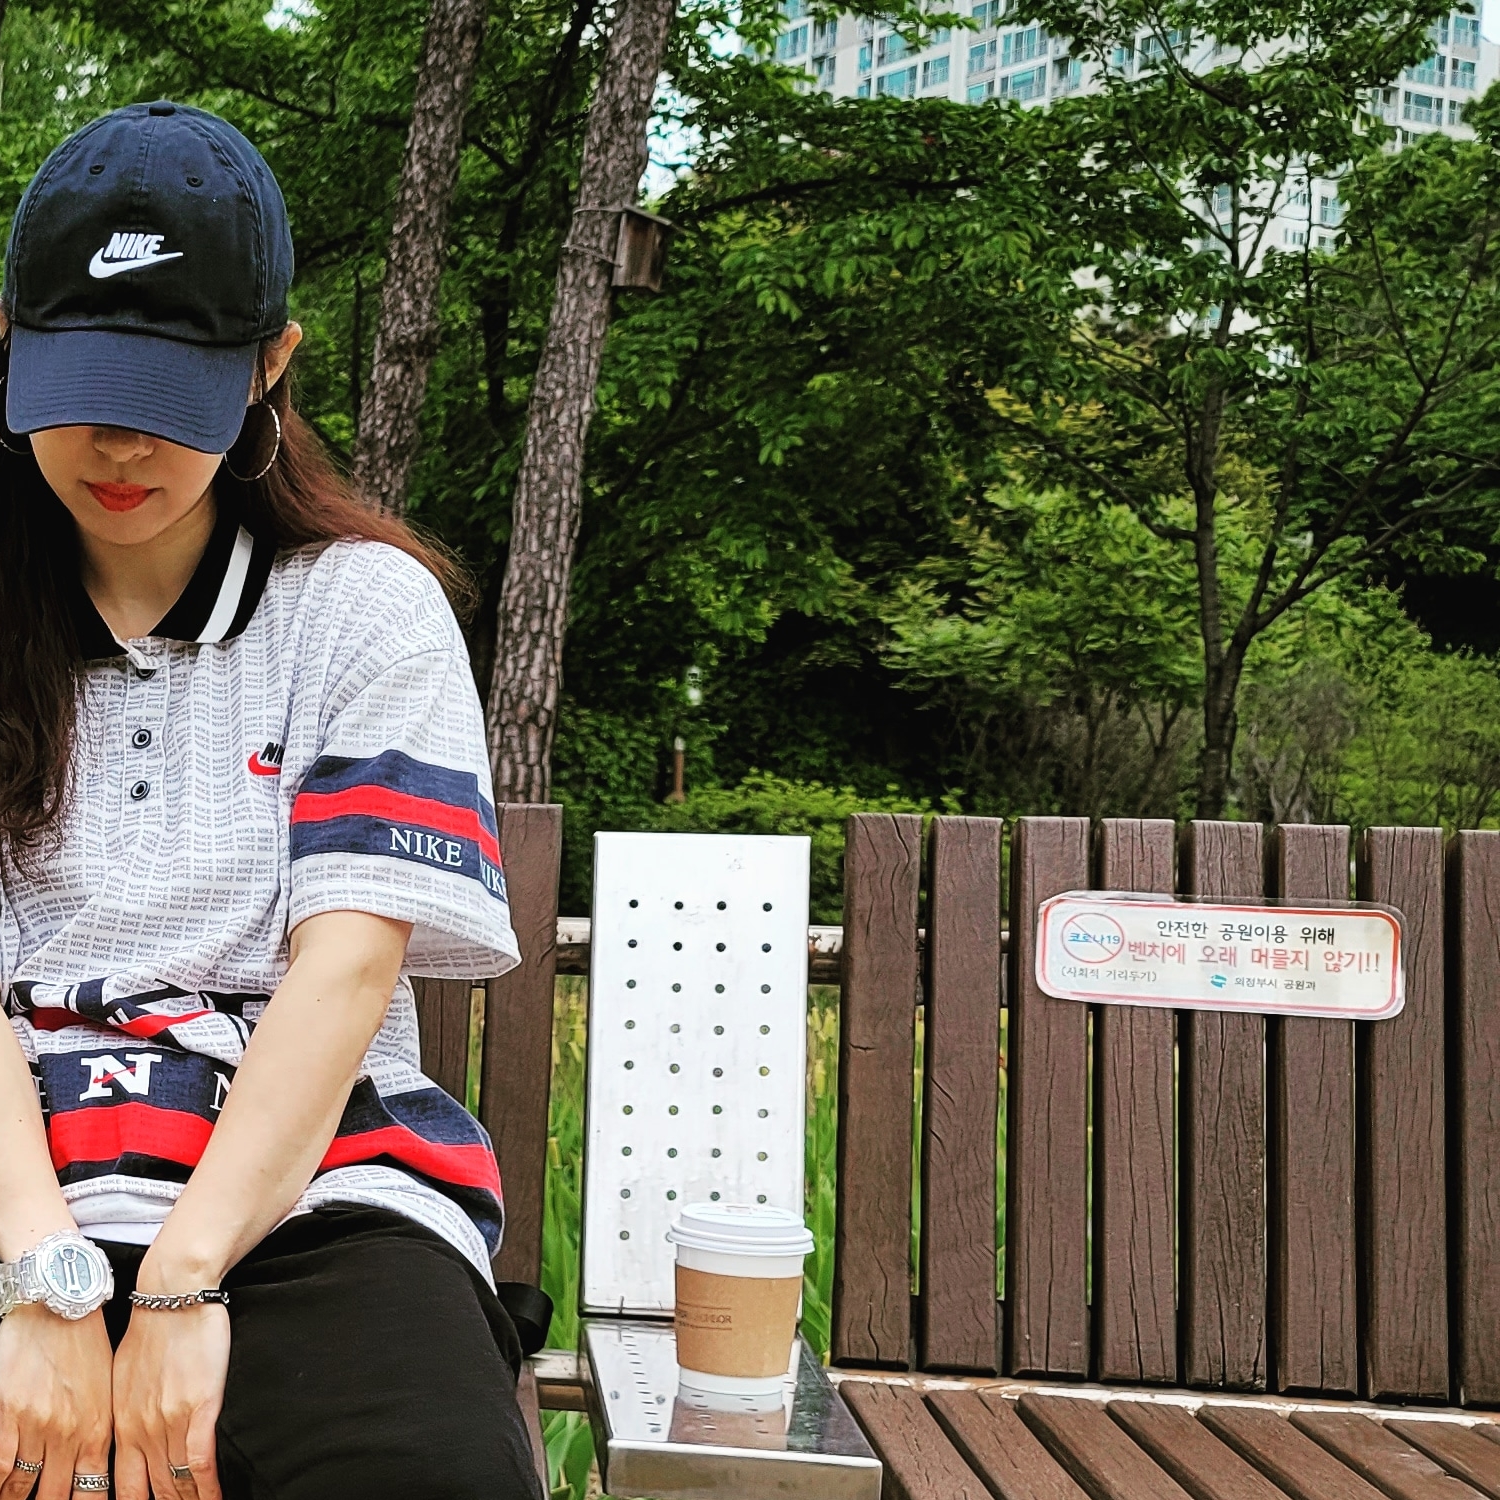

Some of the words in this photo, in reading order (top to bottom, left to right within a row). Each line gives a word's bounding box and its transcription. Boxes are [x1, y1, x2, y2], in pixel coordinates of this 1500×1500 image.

[104, 232, 164, 258] NIKE
[260, 742, 286, 765] NI
[389, 827, 463, 867] NIKE
[1068, 932, 1121, 945] 코로나19
[1157, 920, 1208, 939] 안전한
[1219, 923, 1288, 944] 공원이용
[1300, 927, 1335, 945] 위해
[1128, 941, 1186, 965] 벤치에
[1198, 945, 1237, 968] 오래
[1251, 947, 1309, 971] 머물지
[1323, 950, 1380, 974] 않기!!
[1061, 966, 1100, 979] (사회적
[1234, 977, 1277, 989] 의정부시
[1283, 979, 1316, 991] 공원과
[79, 1053, 162, 1102] N
